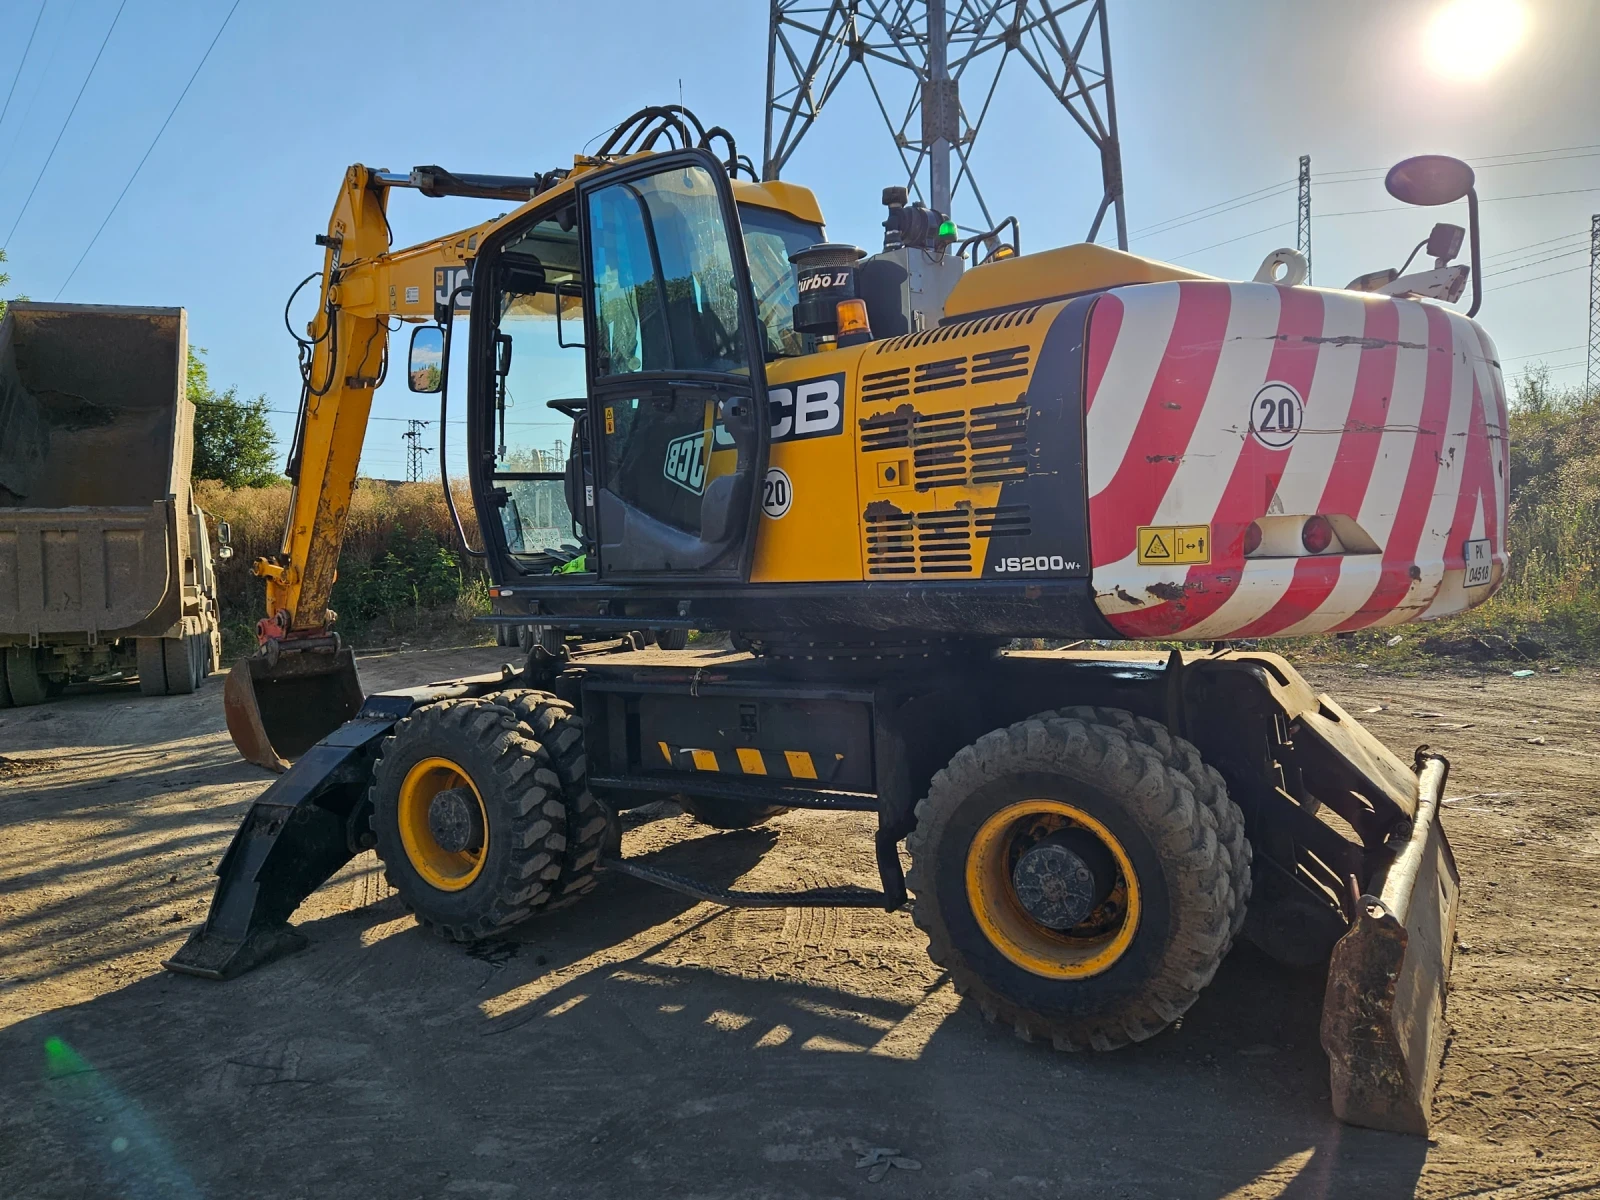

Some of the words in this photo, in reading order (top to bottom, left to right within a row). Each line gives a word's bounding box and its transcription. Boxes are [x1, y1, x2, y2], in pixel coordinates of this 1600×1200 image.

[436, 269, 472, 307] JC
[833, 272, 849, 286] II
[1260, 398, 1294, 432] 20
[764, 480, 786, 507] 20
[1475, 544, 1484, 559] PK
